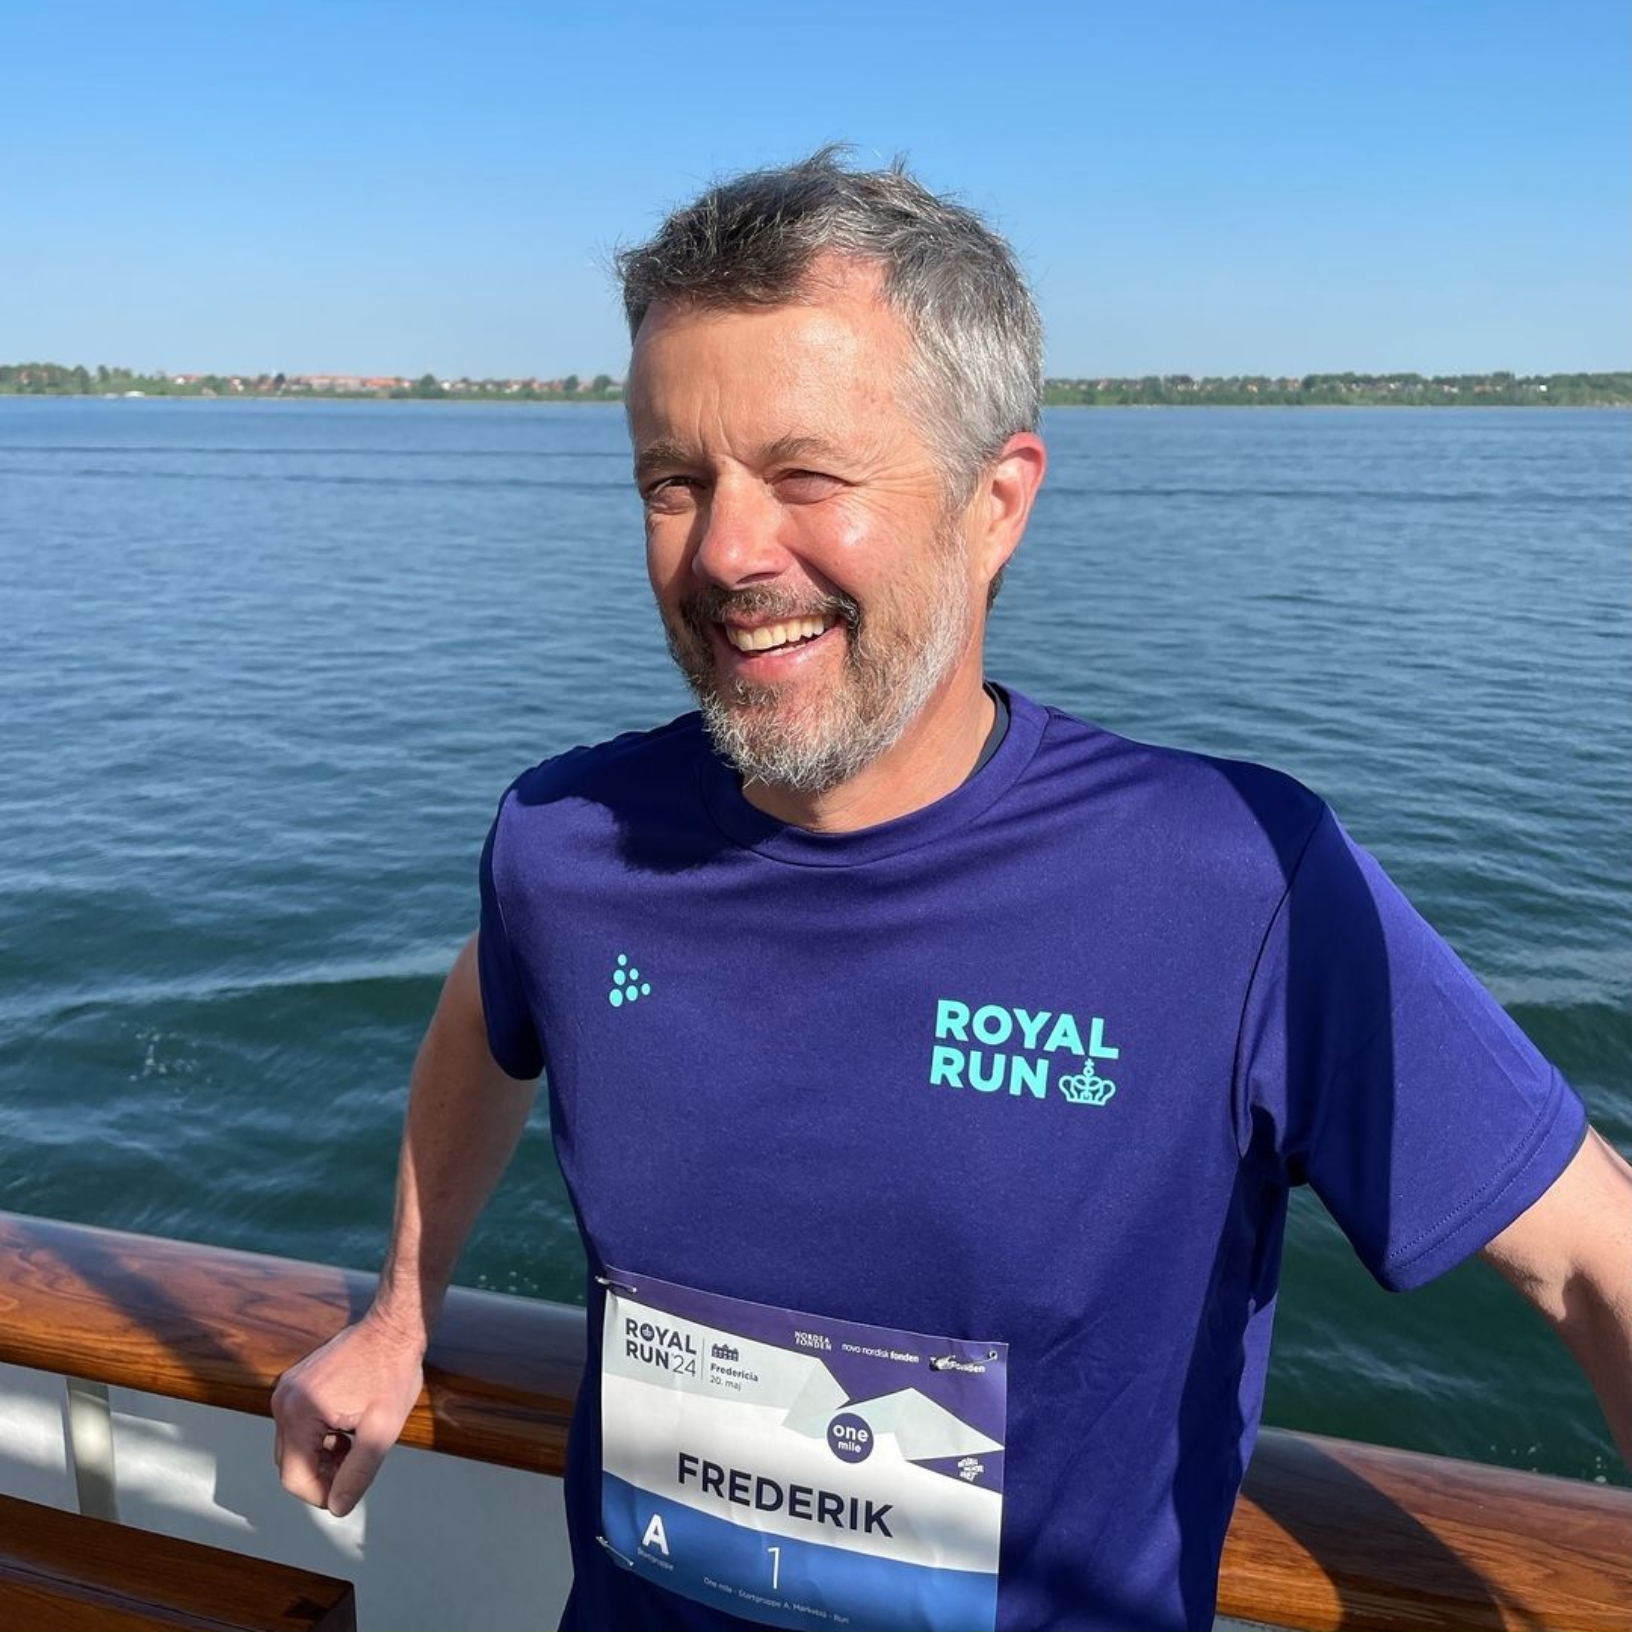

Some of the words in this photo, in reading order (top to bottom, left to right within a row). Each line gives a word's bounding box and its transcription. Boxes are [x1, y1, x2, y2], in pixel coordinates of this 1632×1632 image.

[935, 999, 1119, 1060] ROYAL
[930, 1045, 1049, 1099] RUN
[626, 1317, 697, 1355] ROYAL
[890, 1351, 920, 1363] fonden
[710, 1363, 759, 1382] Fredericia
[710, 1375, 723, 1386] 20.
[724, 1381, 742, 1391] maj
[833, 1424, 869, 1442] one
[838, 1441, 862, 1453] mile
[677, 1452, 893, 1539] FREDERIK
[642, 1514, 669, 1556] A
[768, 1547, 781, 1590] 1
